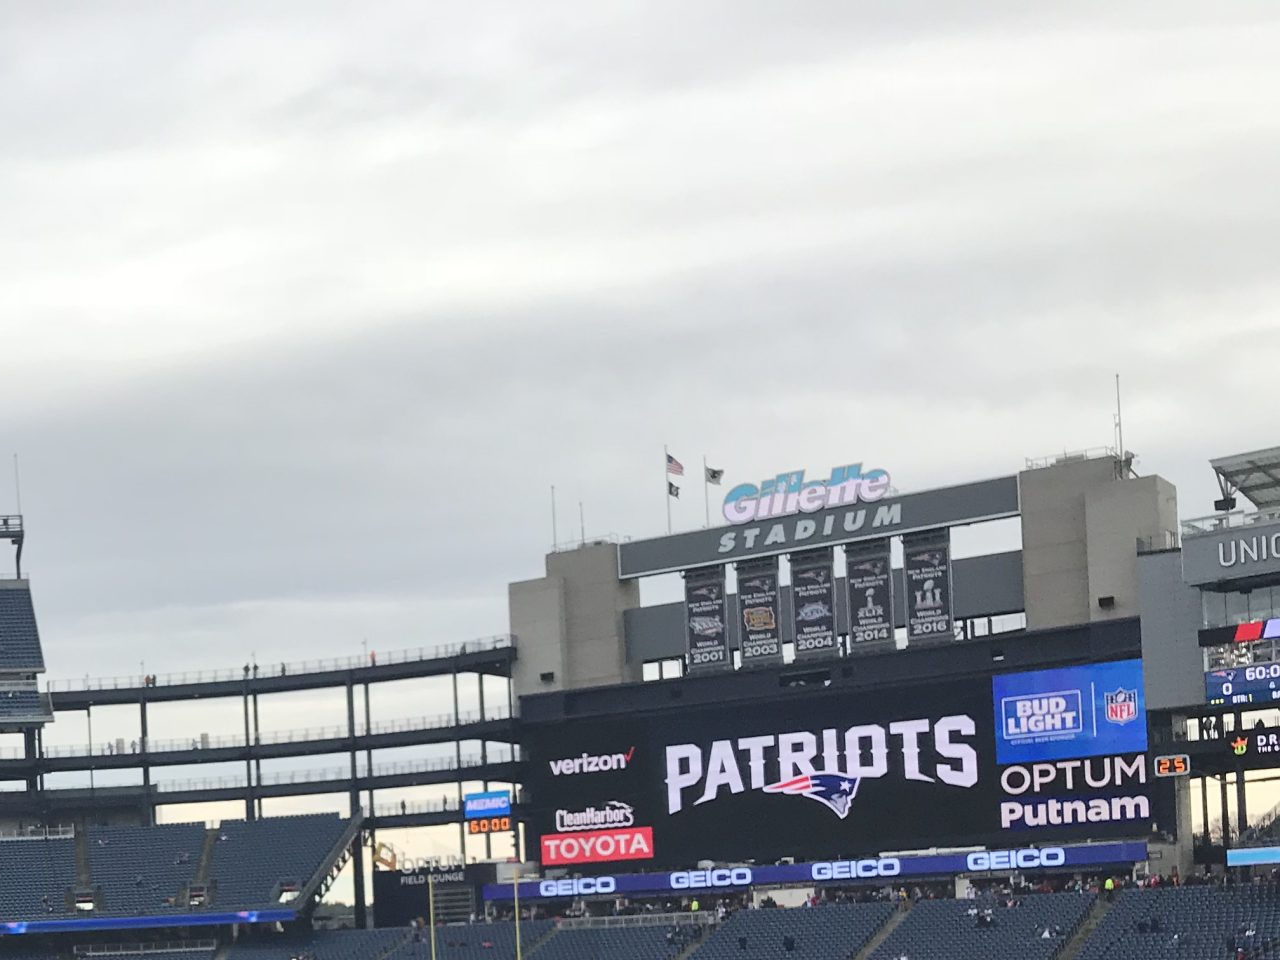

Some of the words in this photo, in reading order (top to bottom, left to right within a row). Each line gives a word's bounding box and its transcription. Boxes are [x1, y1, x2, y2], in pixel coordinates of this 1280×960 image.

[722, 462, 891, 525] Gillette
[718, 503, 902, 553] STADIUM
[855, 630, 888, 642] 2014
[913, 621, 946, 635] 2016
[744, 644, 778, 657] 2003
[798, 637, 833, 650] 2004
[693, 651, 723, 663] 2001
[1222, 682, 1232, 695] 0
[1016, 696, 1066, 718] BUD
[1109, 703, 1134, 719] NFL
[1007, 711, 1077, 735] LIGHT
[549, 752, 627, 776] verizon
[664, 714, 979, 816] PATRIOTS
[1000, 754, 1147, 796] OPTUM
[1158, 757, 1186, 774] 25
[1000, 795, 1150, 829] Putnam
[543, 832, 650, 860] TOYOTA
[811, 857, 901, 881] GEICO
[966, 846, 1066, 872] GEICO
[539, 876, 616, 897] GEICO
[670, 867, 752, 889] GEICO
